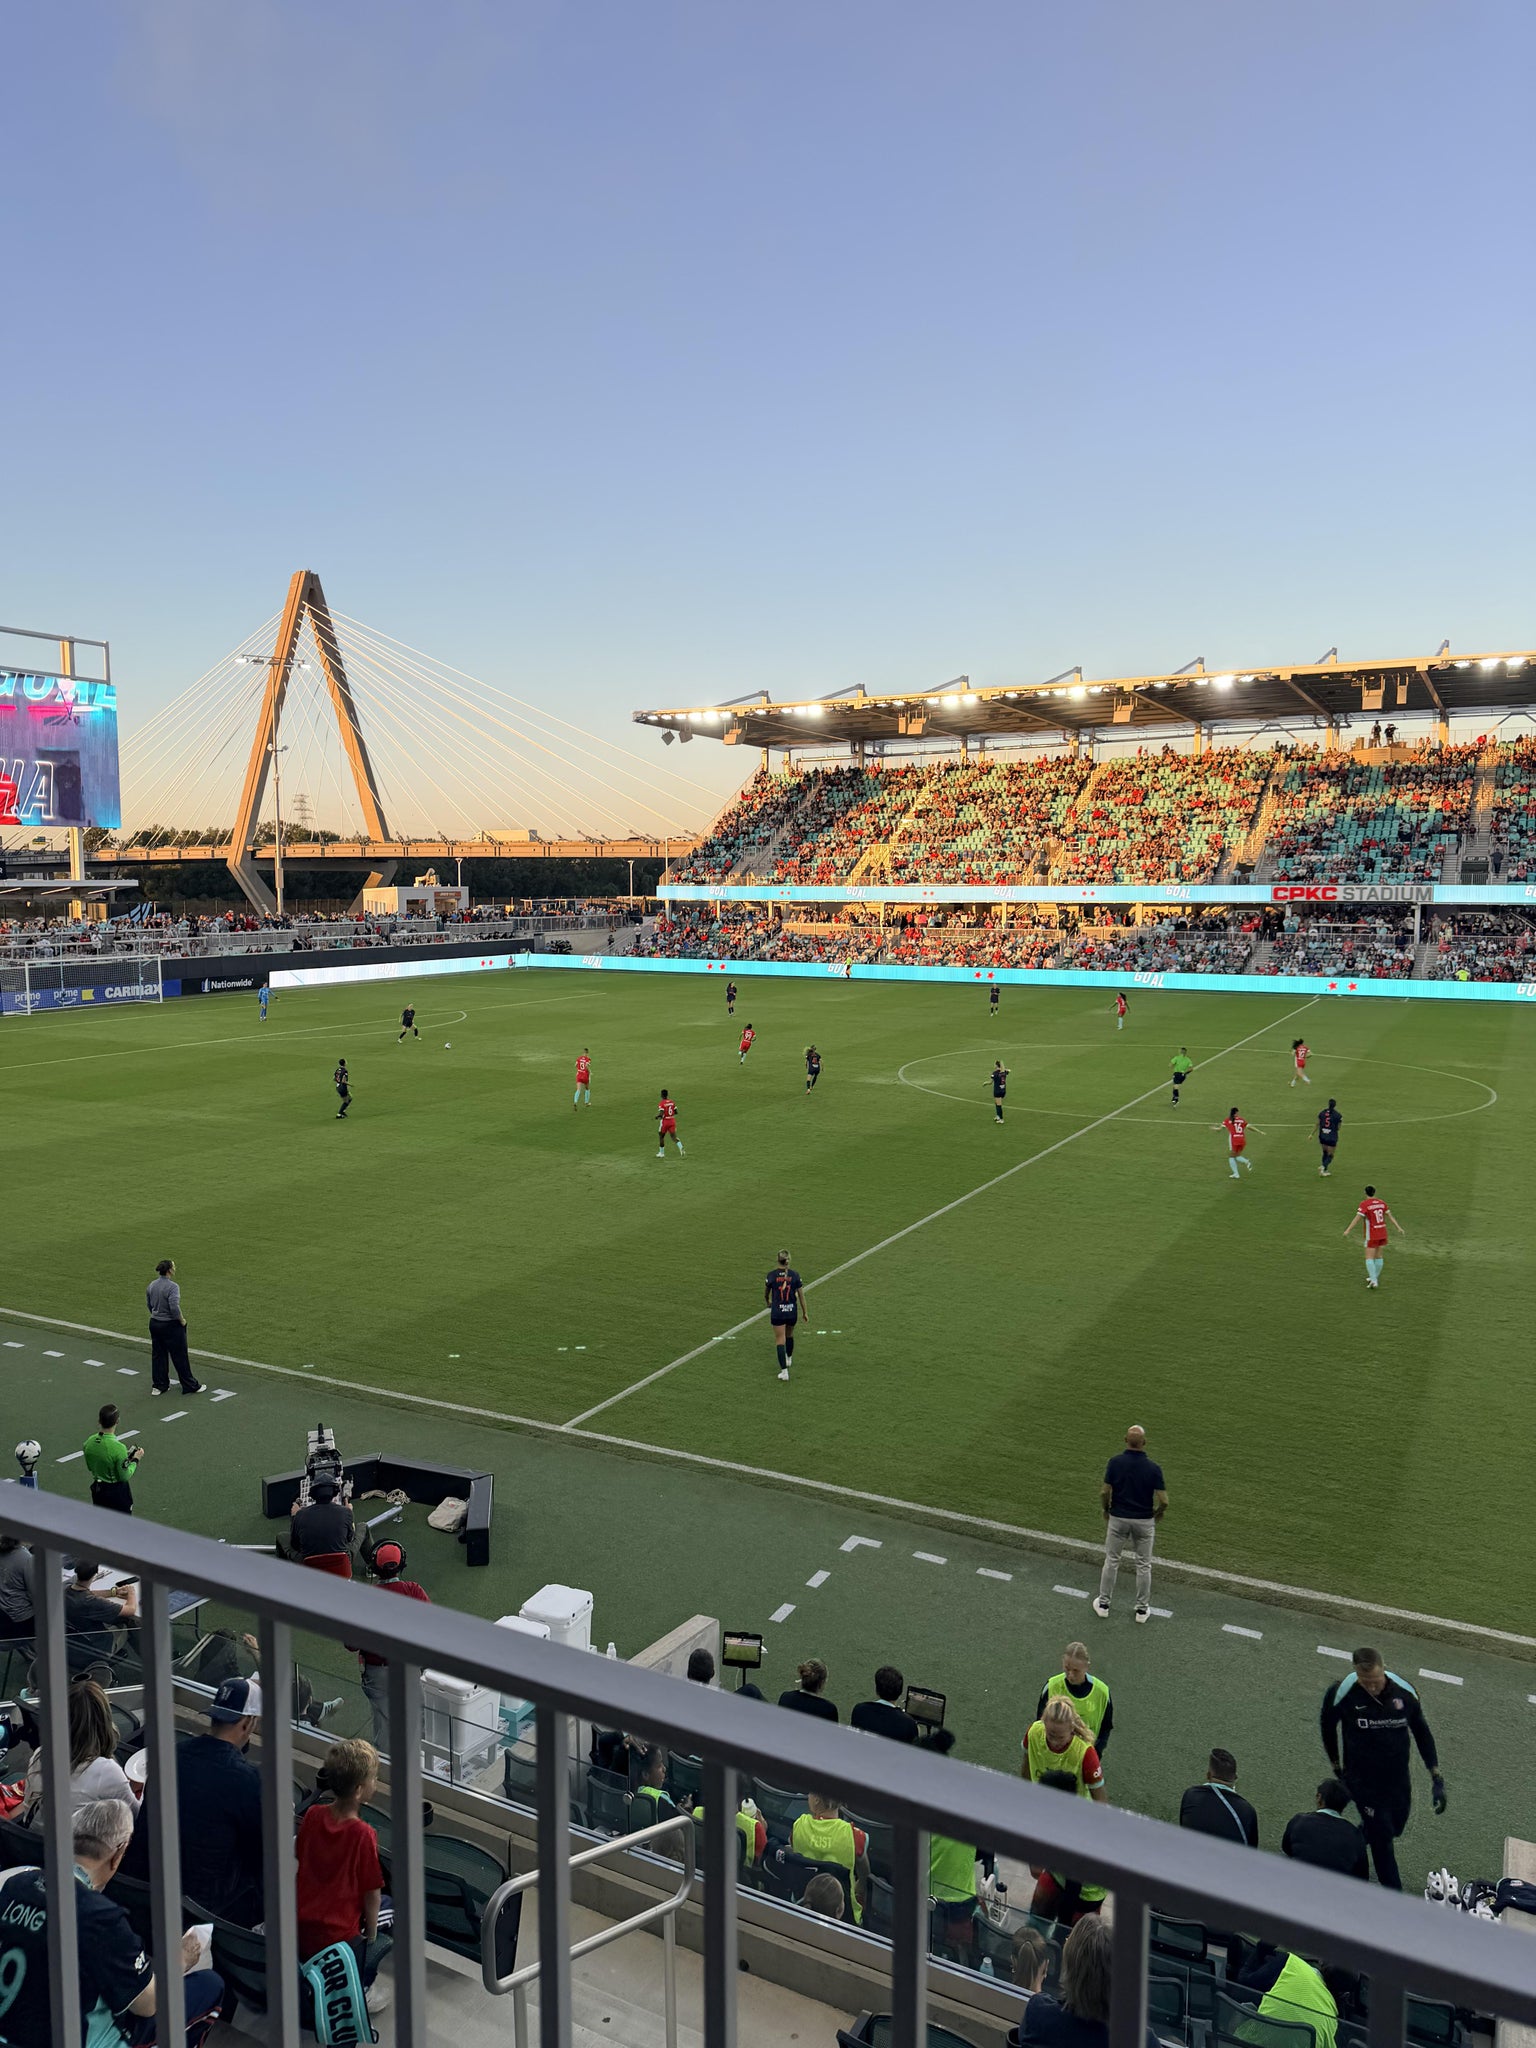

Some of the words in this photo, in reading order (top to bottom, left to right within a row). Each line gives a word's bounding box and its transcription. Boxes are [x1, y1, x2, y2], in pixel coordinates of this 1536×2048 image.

[709, 886, 728, 897] GOAL
[846, 886, 867, 898] GOAL
[993, 887, 1016, 899] GOAL
[1166, 885, 1191, 899] GOAL
[1273, 887, 1337, 900] CPKC
[1342, 887, 1432, 901] STADIUM
[211, 978, 253, 989] Nationwide
[1134, 972, 1165, 988] GOAL
[1234, 1123, 1243, 1134] 16
[1, 1899, 47, 1932] LONG
[312, 1948, 349, 1997] FOR
